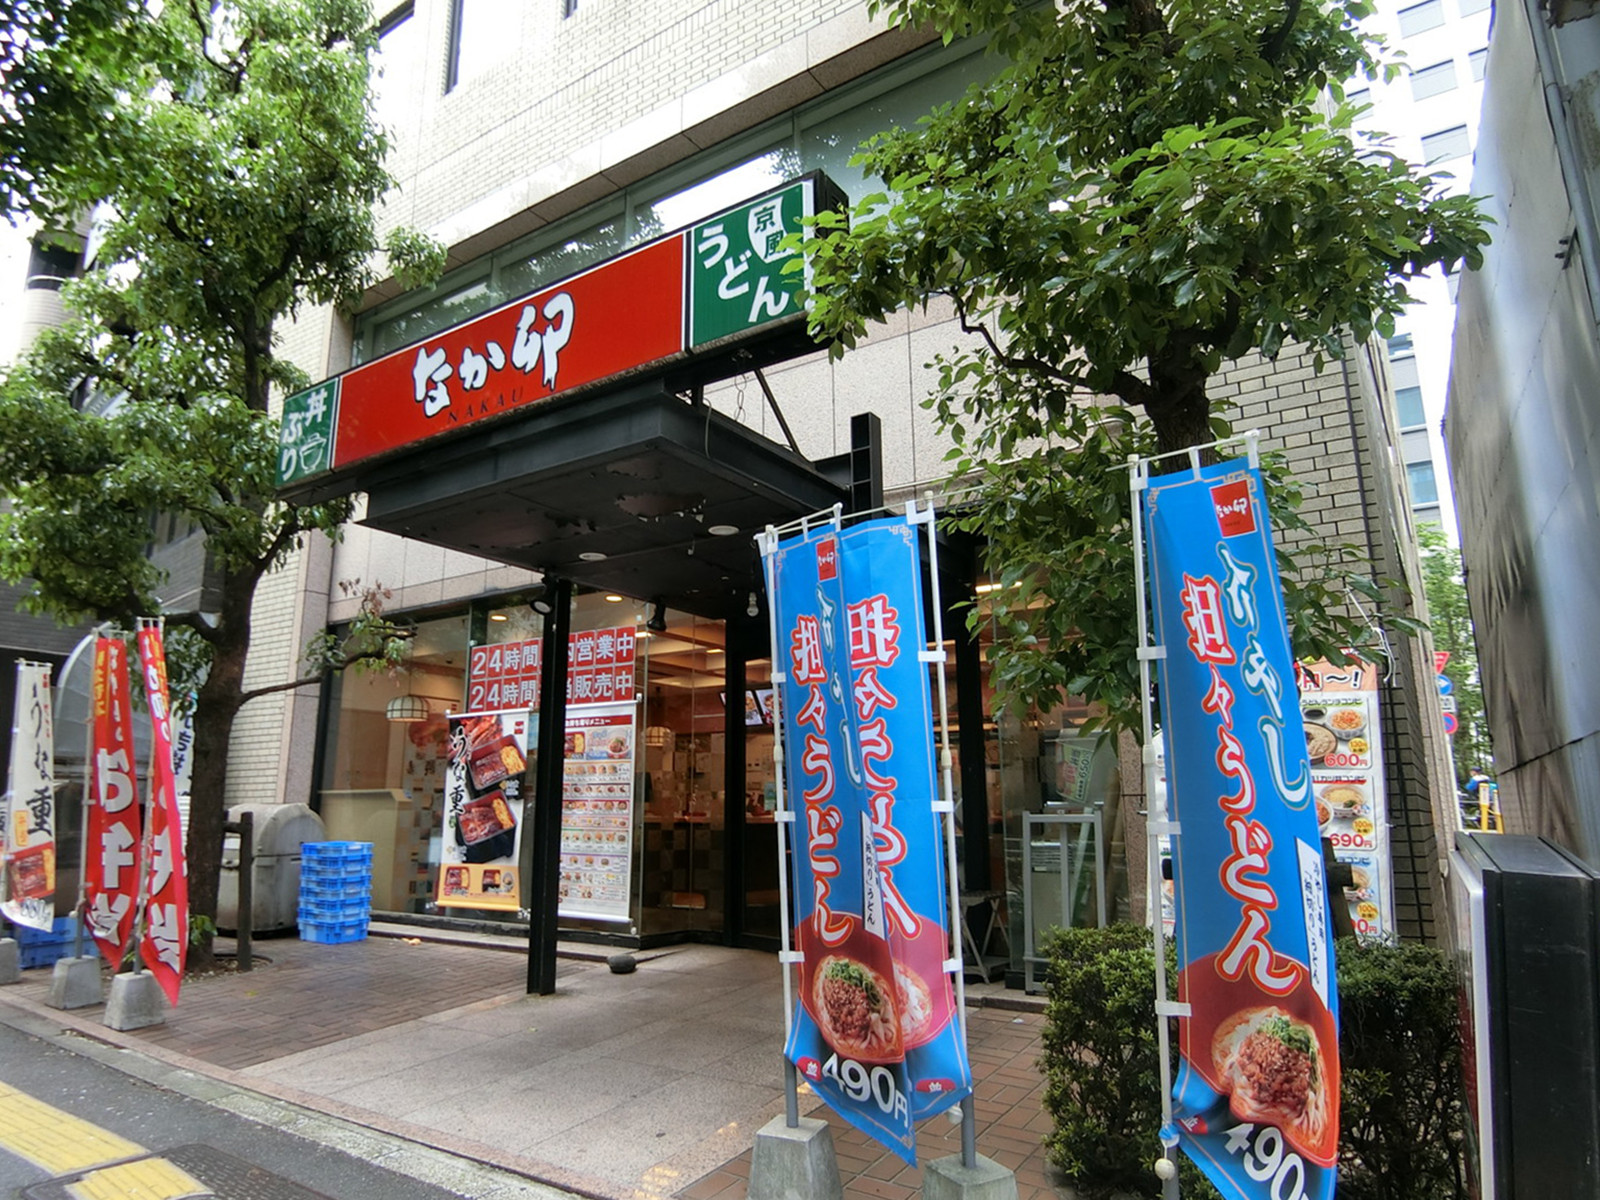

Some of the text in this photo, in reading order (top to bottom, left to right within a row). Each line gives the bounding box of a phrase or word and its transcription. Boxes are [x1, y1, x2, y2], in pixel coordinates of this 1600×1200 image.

[697, 224, 790, 323] うどん
[412, 292, 575, 418] なか卯
[448, 386, 524, 425] NAKAU
[1324, 752, 1369, 768] 600円
[1329, 833, 1373, 849] 690円
[1220, 1122, 1310, 1200] 490
